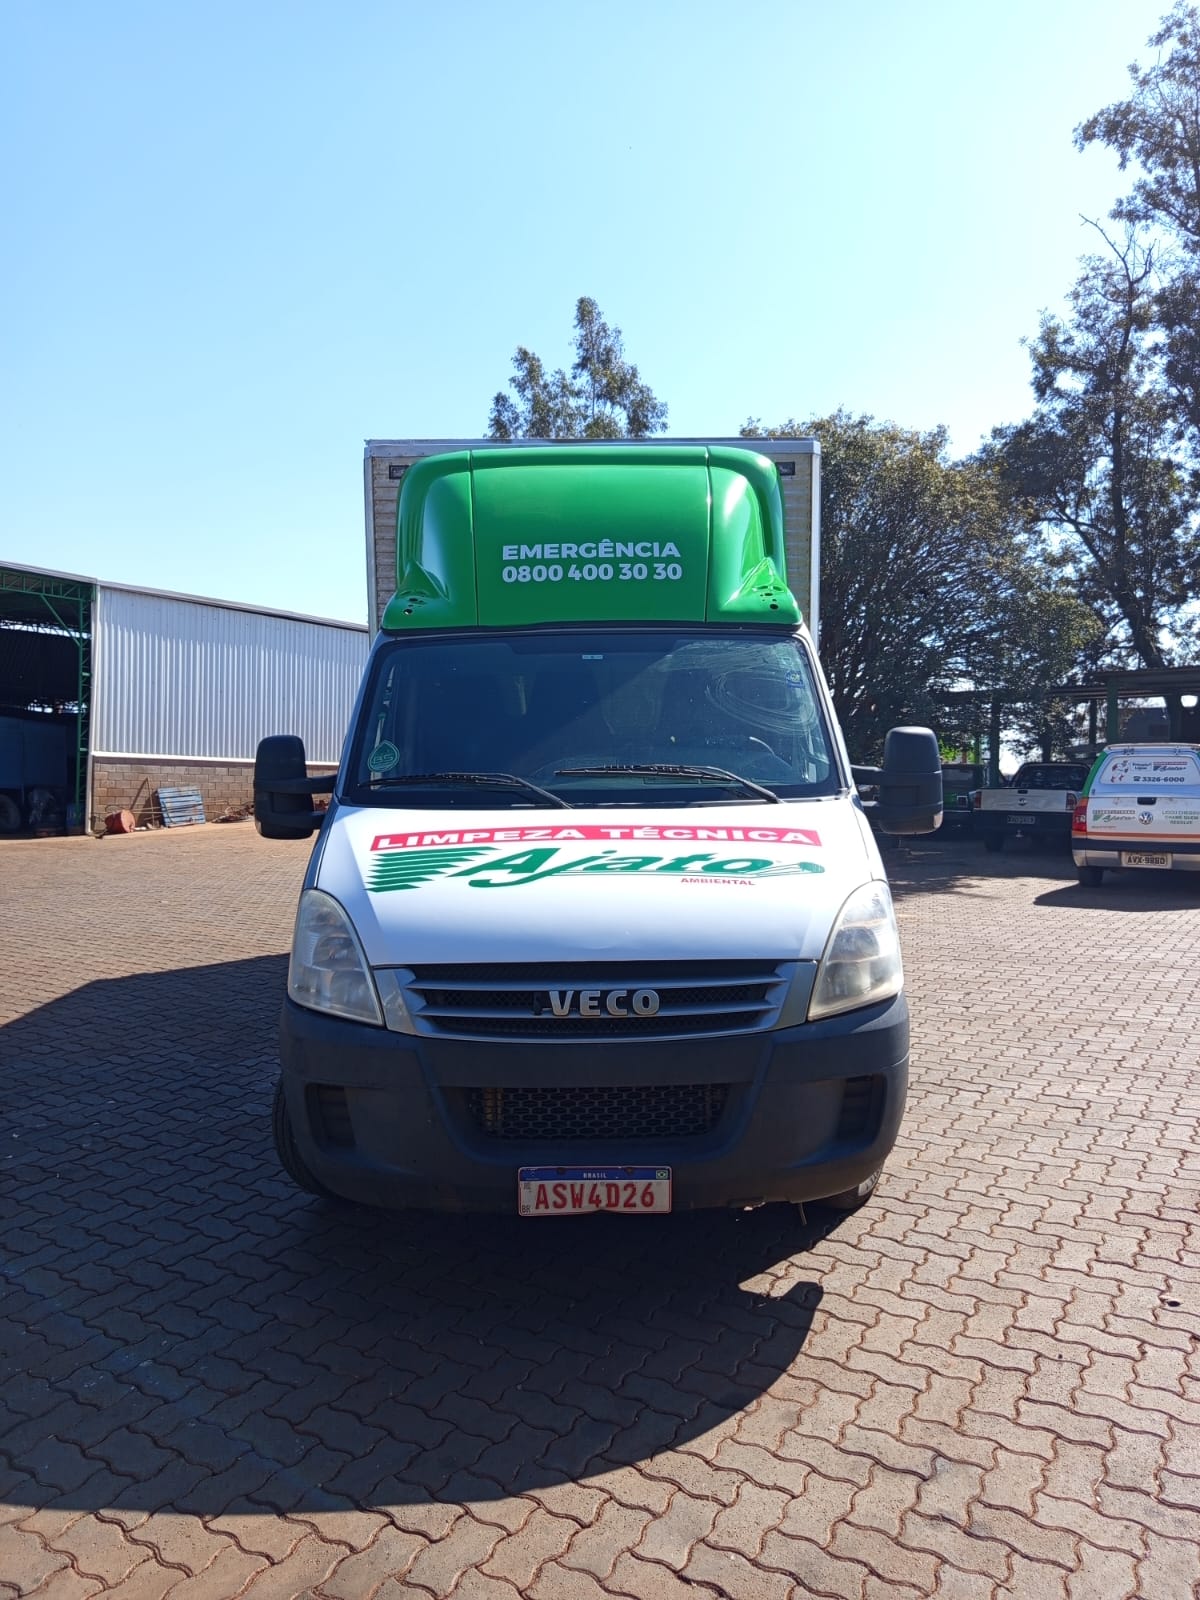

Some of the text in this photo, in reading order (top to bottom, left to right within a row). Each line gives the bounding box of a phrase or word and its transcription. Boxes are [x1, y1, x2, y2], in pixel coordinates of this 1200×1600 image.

[503, 539, 681, 560] EMERGÊNCIA
[502, 563, 682, 582] 0800 400 30 30
[377, 827, 815, 849] LIMPEZA TÉCNICA
[445, 848, 775, 888] Ajato
[681, 878, 757, 886] AMBIENTAL
[535, 1183, 655, 1210] ASW4D26
